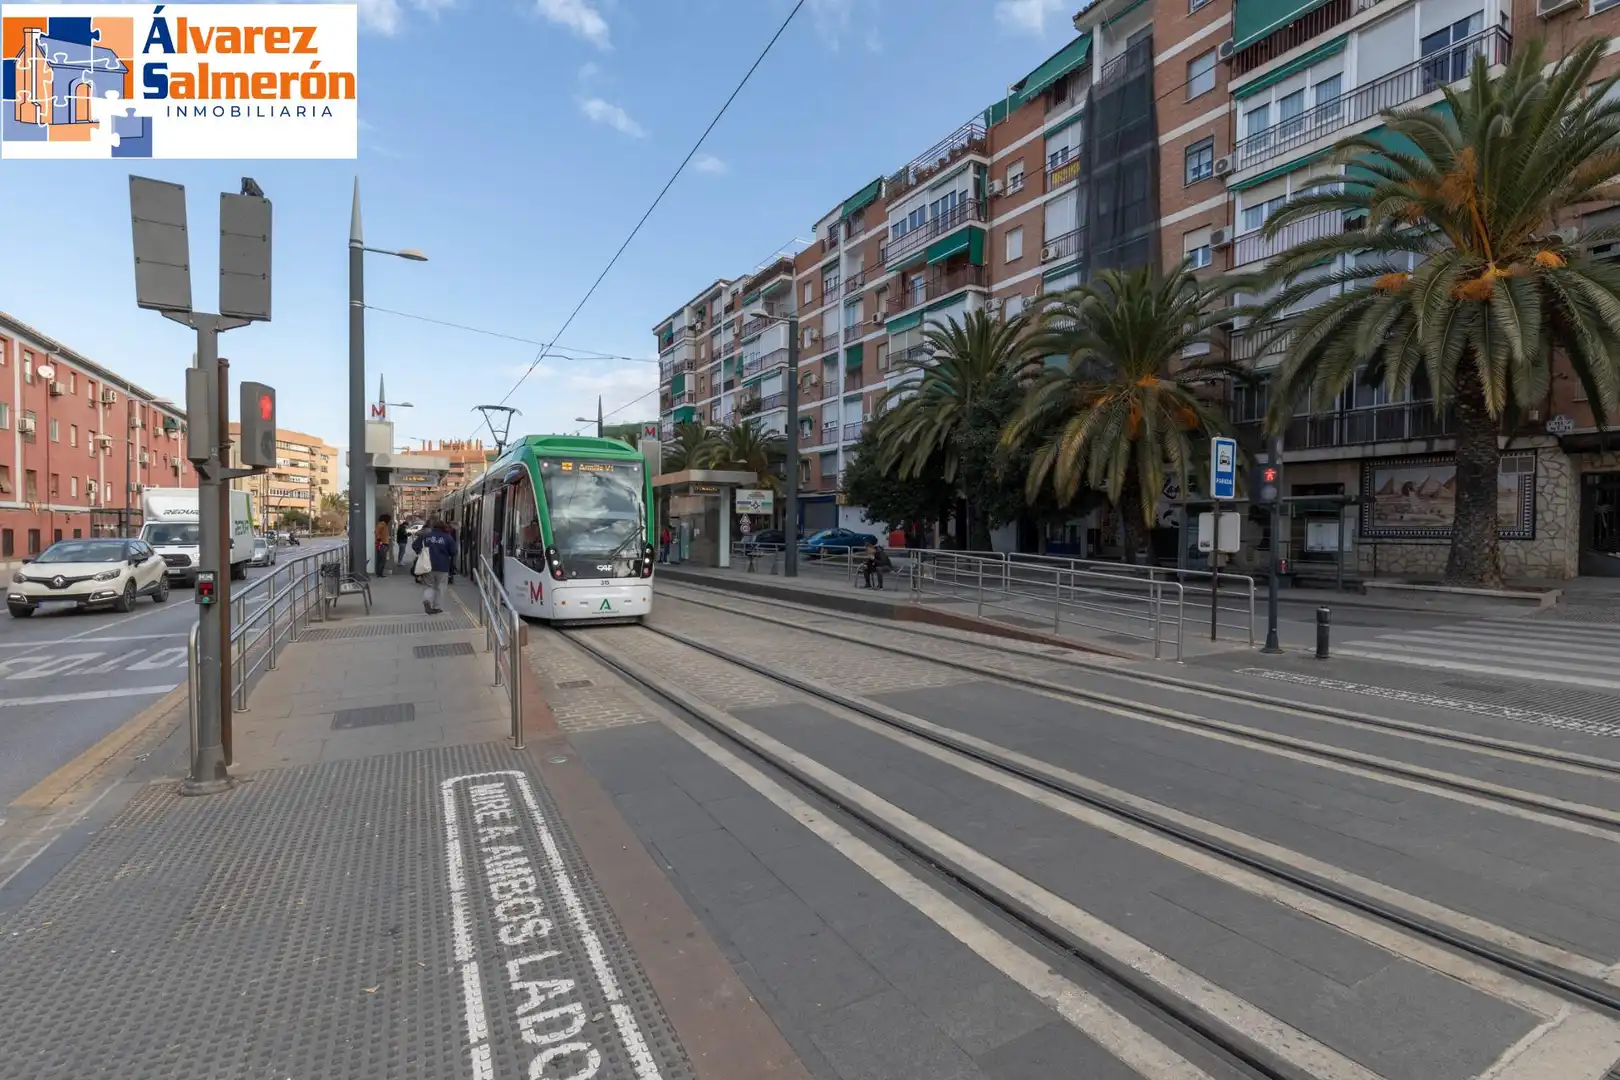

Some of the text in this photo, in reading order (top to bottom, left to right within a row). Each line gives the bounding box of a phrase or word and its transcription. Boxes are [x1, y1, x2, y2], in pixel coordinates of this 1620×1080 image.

[371, 403, 386, 418] M
[644, 426, 656, 437] M
[1216, 477, 1232, 485] PARADA
[596, 564, 613, 572] CAF
[530, 580, 544, 605] M
[468, 782, 512, 824] MIRE
[479, 824, 521, 844] A
[482, 845, 556, 946] AMBOS
